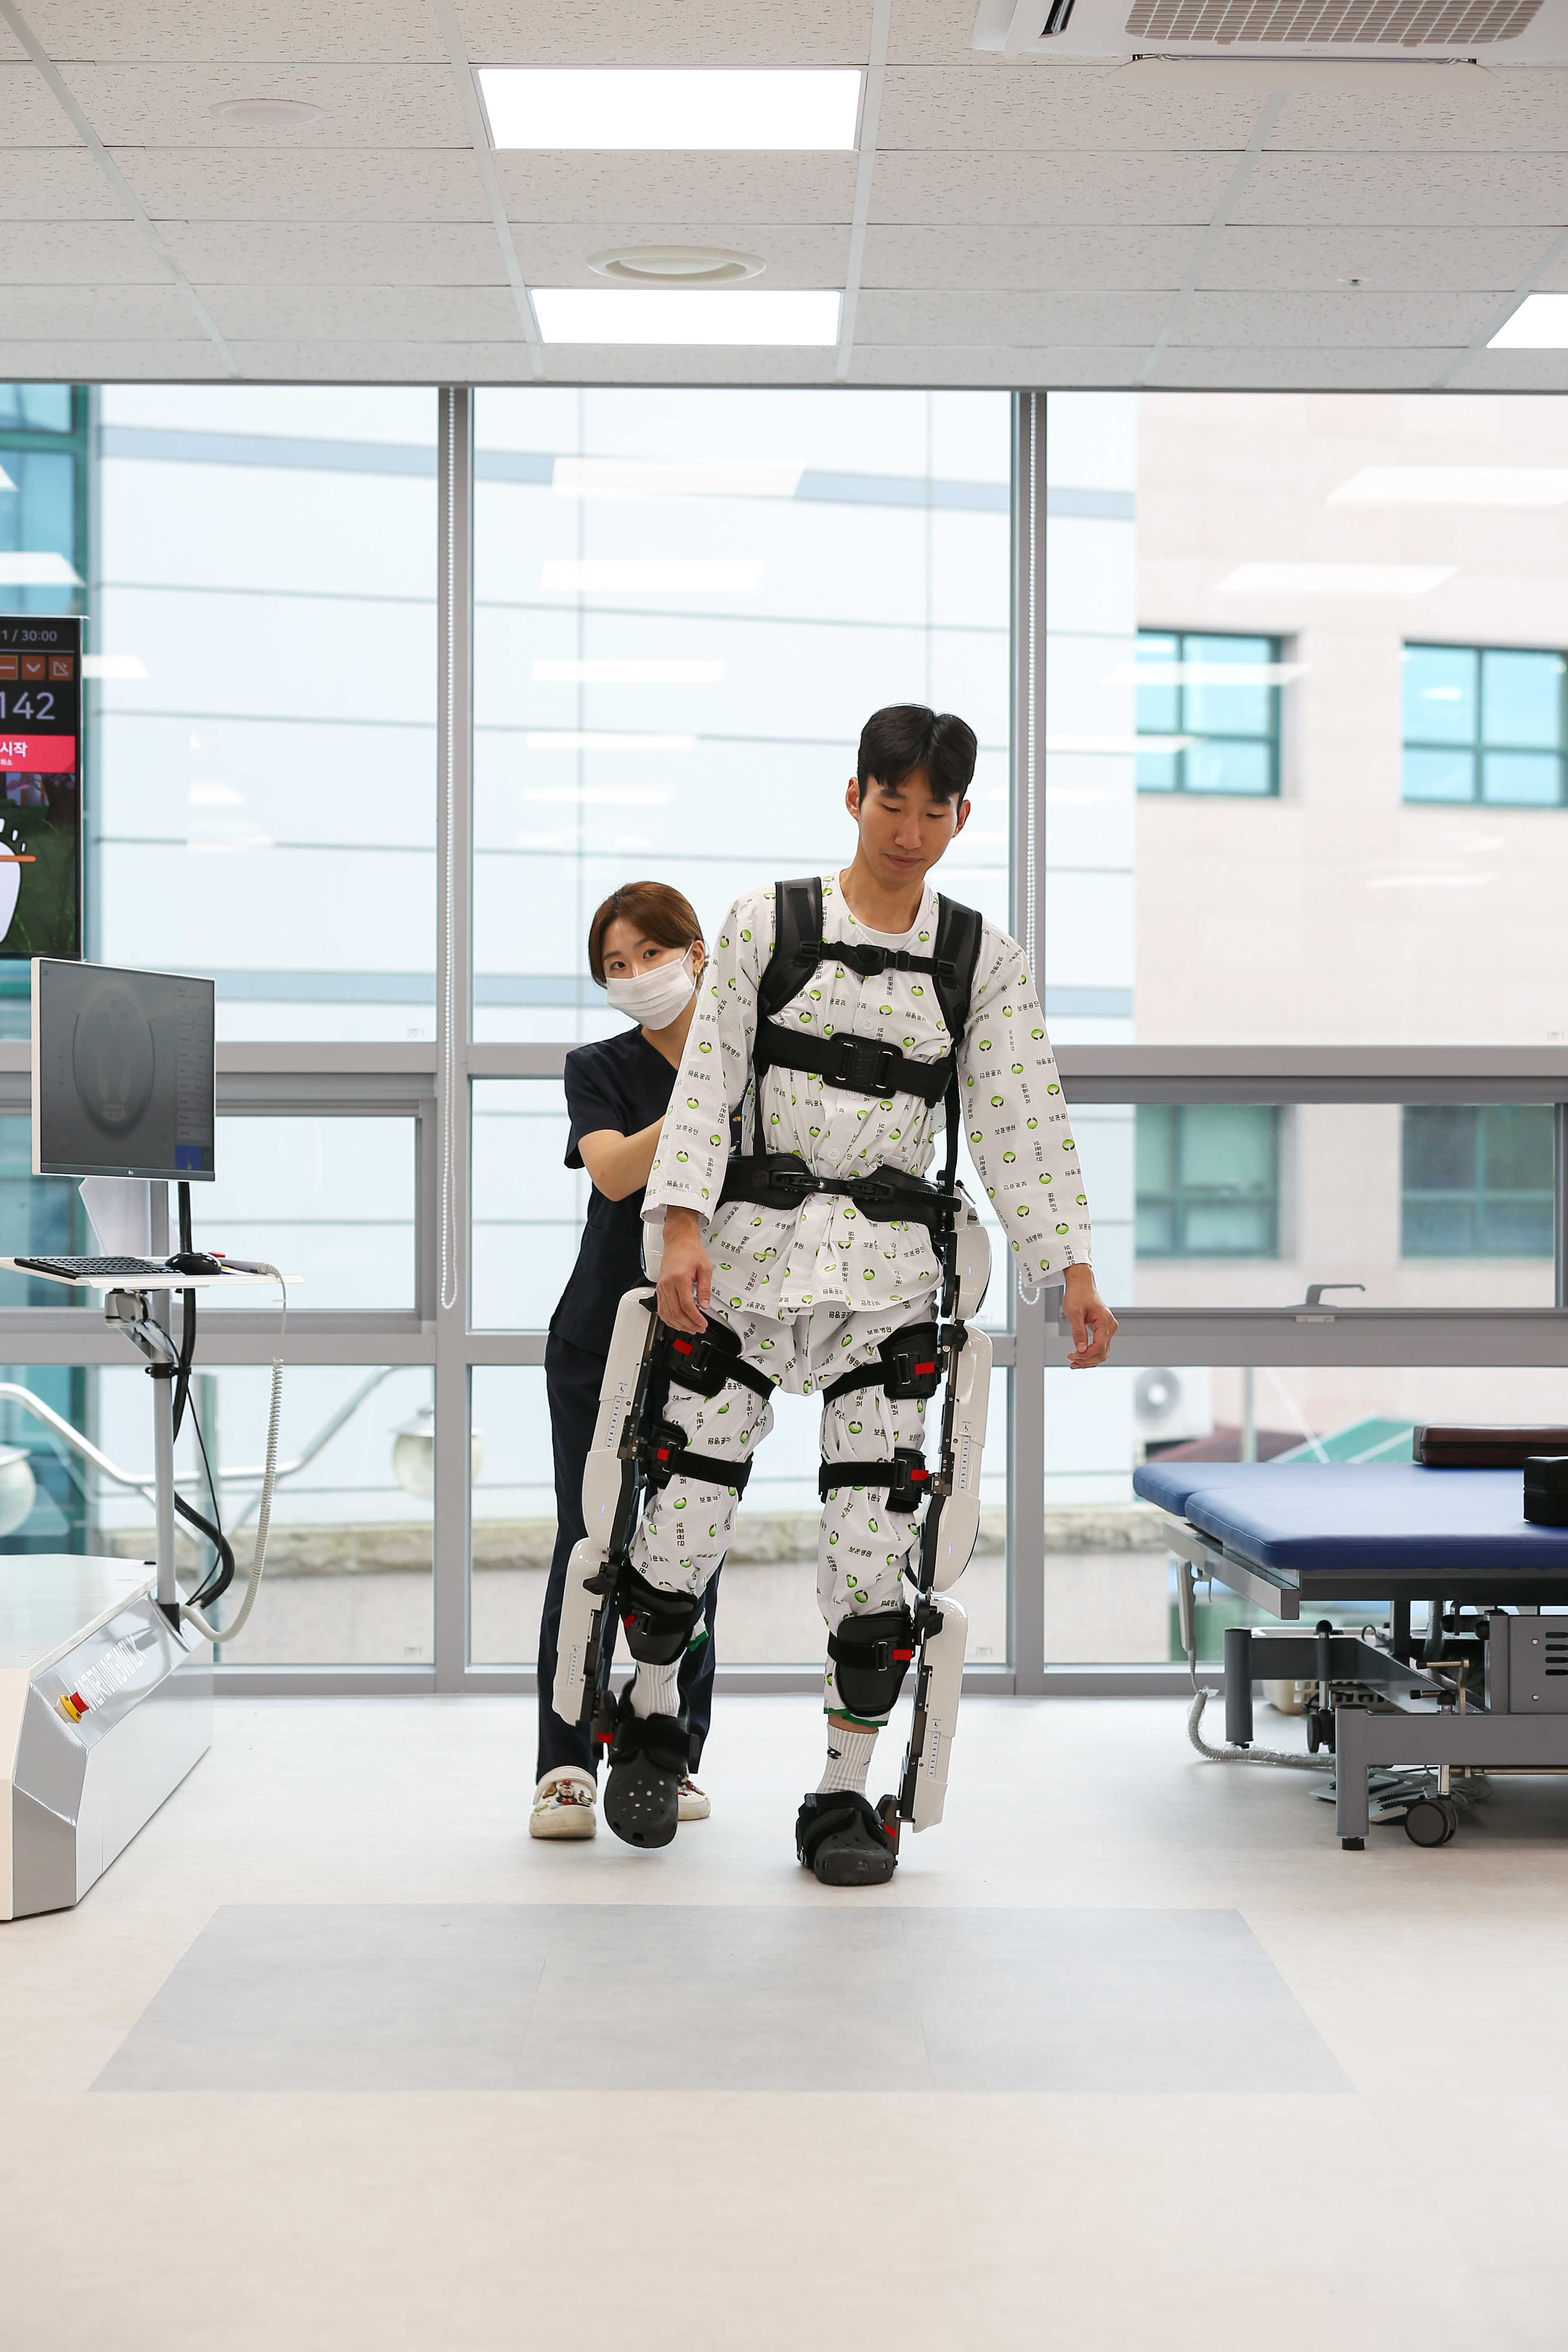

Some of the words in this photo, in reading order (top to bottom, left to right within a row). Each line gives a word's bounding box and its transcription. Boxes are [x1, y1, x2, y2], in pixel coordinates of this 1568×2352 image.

[22, 631, 57, 641] 30:00
[0, 691, 55, 719] 142
[990, 956, 1004, 975] 보훈병원
[736, 994, 752, 1007] 보훈공
[830, 998, 846, 1006] 보훈공
[1017, 1001, 1040, 1012] 보훈공단
[699, 1013, 719, 1025] 보훈공
[720, 1042, 741, 1058] 보훈병원
[688, 1069, 711, 1081] 보훈병원
[980, 1069, 1002, 1079] 보훈공단
[1020, 1083, 1031, 1104] 보훈병원
[717, 1102, 727, 1124] 보훈공단
[1049, 1113, 1068, 1122] 보훈공
[675, 1124, 699, 1136] 보훈공단
[995, 1124, 1016, 1135] 보훈병원
[1033, 1141, 1043, 1162] 보훈공단
[706, 1157, 714, 1178] 보훈병원
[978, 1155, 987, 1176] 보훈병원
[667, 1180, 690, 1189] 보훈병원
[1003, 1181, 1027, 1190] 보훈공단
[1047, 1192, 1058, 1212] 보훈병원
[1025, 1232, 1043, 1244] 보훈병원
[903, 1247, 925, 1258] 보훈공단
[1064, 1245, 1075, 1265] 보훈공단
[1023, 1262, 1033, 1283] 보훈병원
[744, 1272, 757, 1292] 보훈공단
[866, 1326, 891, 1335] 보훈병원
[676, 1522, 685, 1546] 보훈공단
[848, 1546, 873, 1557] 보훈병원
